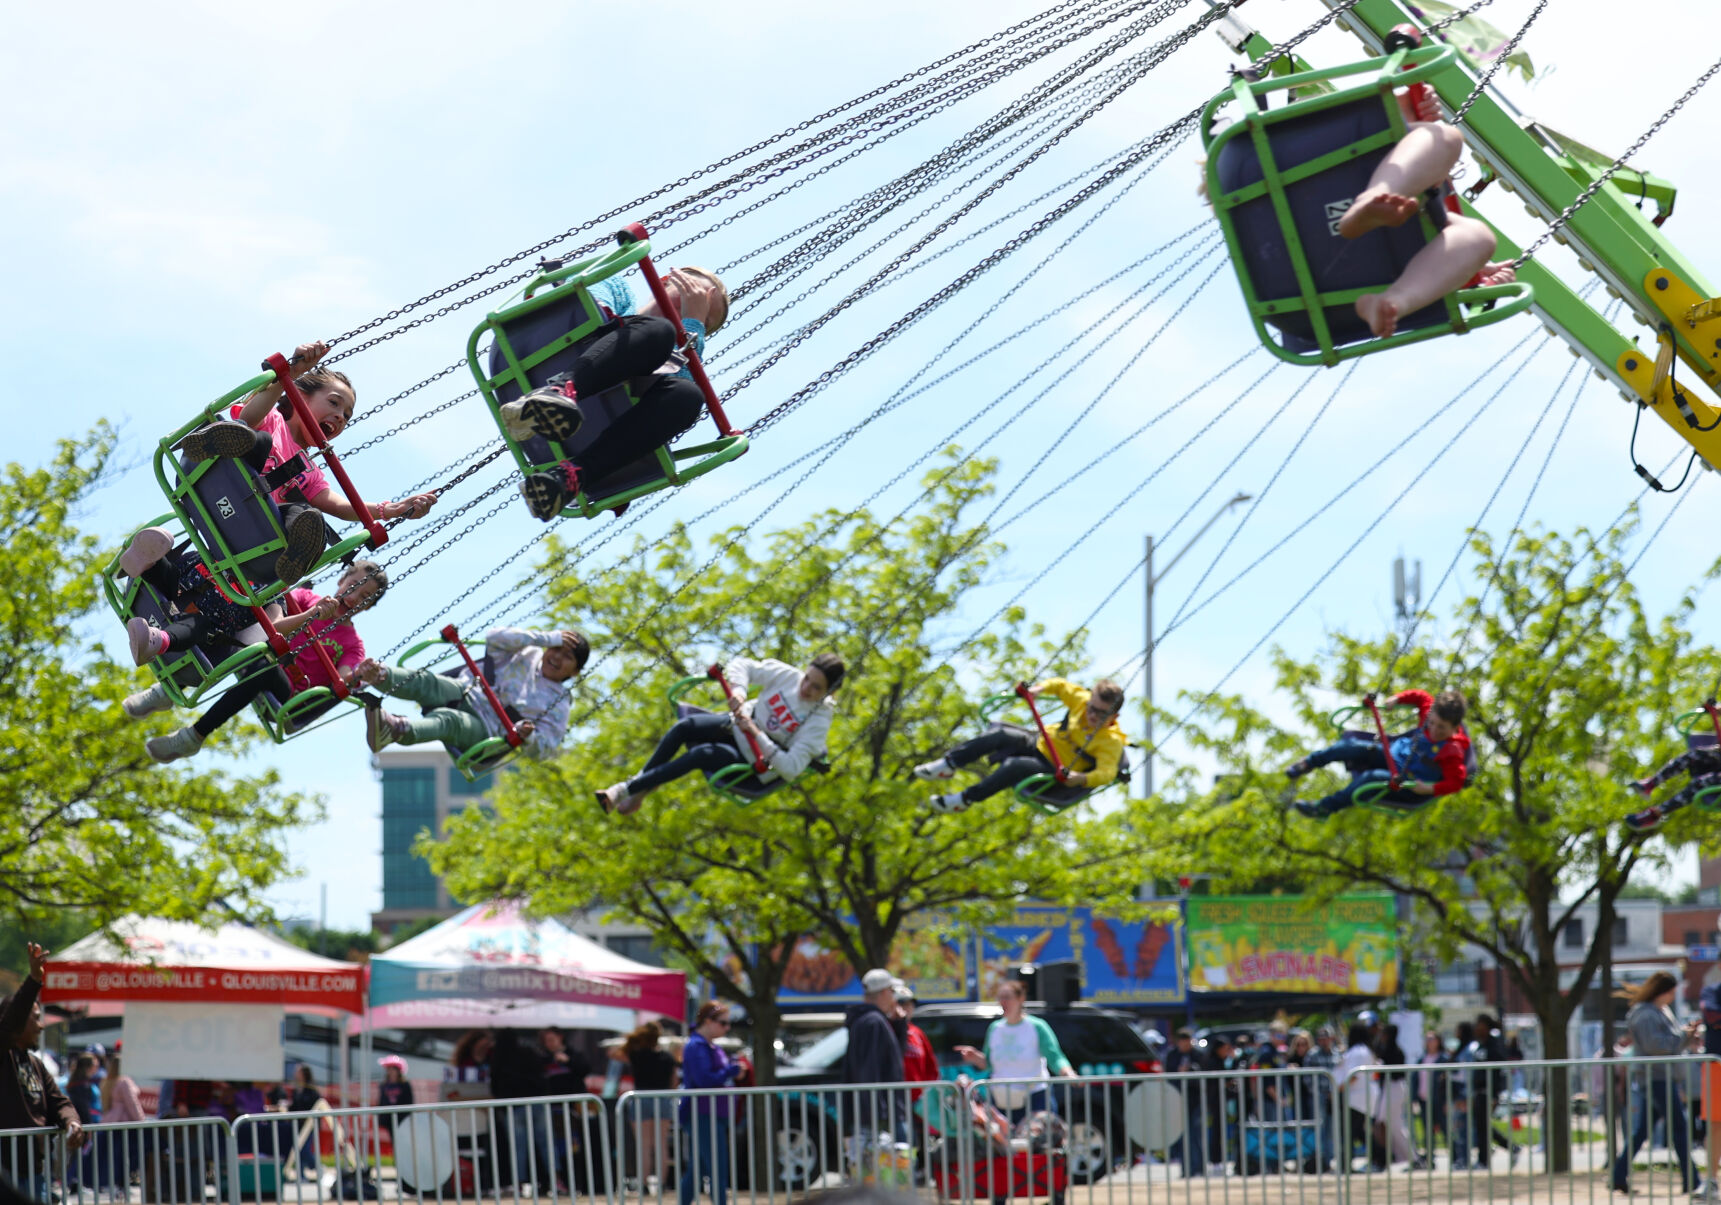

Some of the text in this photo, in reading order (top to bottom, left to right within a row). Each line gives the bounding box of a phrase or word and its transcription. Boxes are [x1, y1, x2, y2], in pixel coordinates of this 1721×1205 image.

[217, 499, 234, 517] 23
[768, 693, 800, 733] BATS
[96, 971, 357, 993] @QLOUISVILLE QLOUISVILLE.COM
[1228, 950, 1352, 987] LEMONADE
